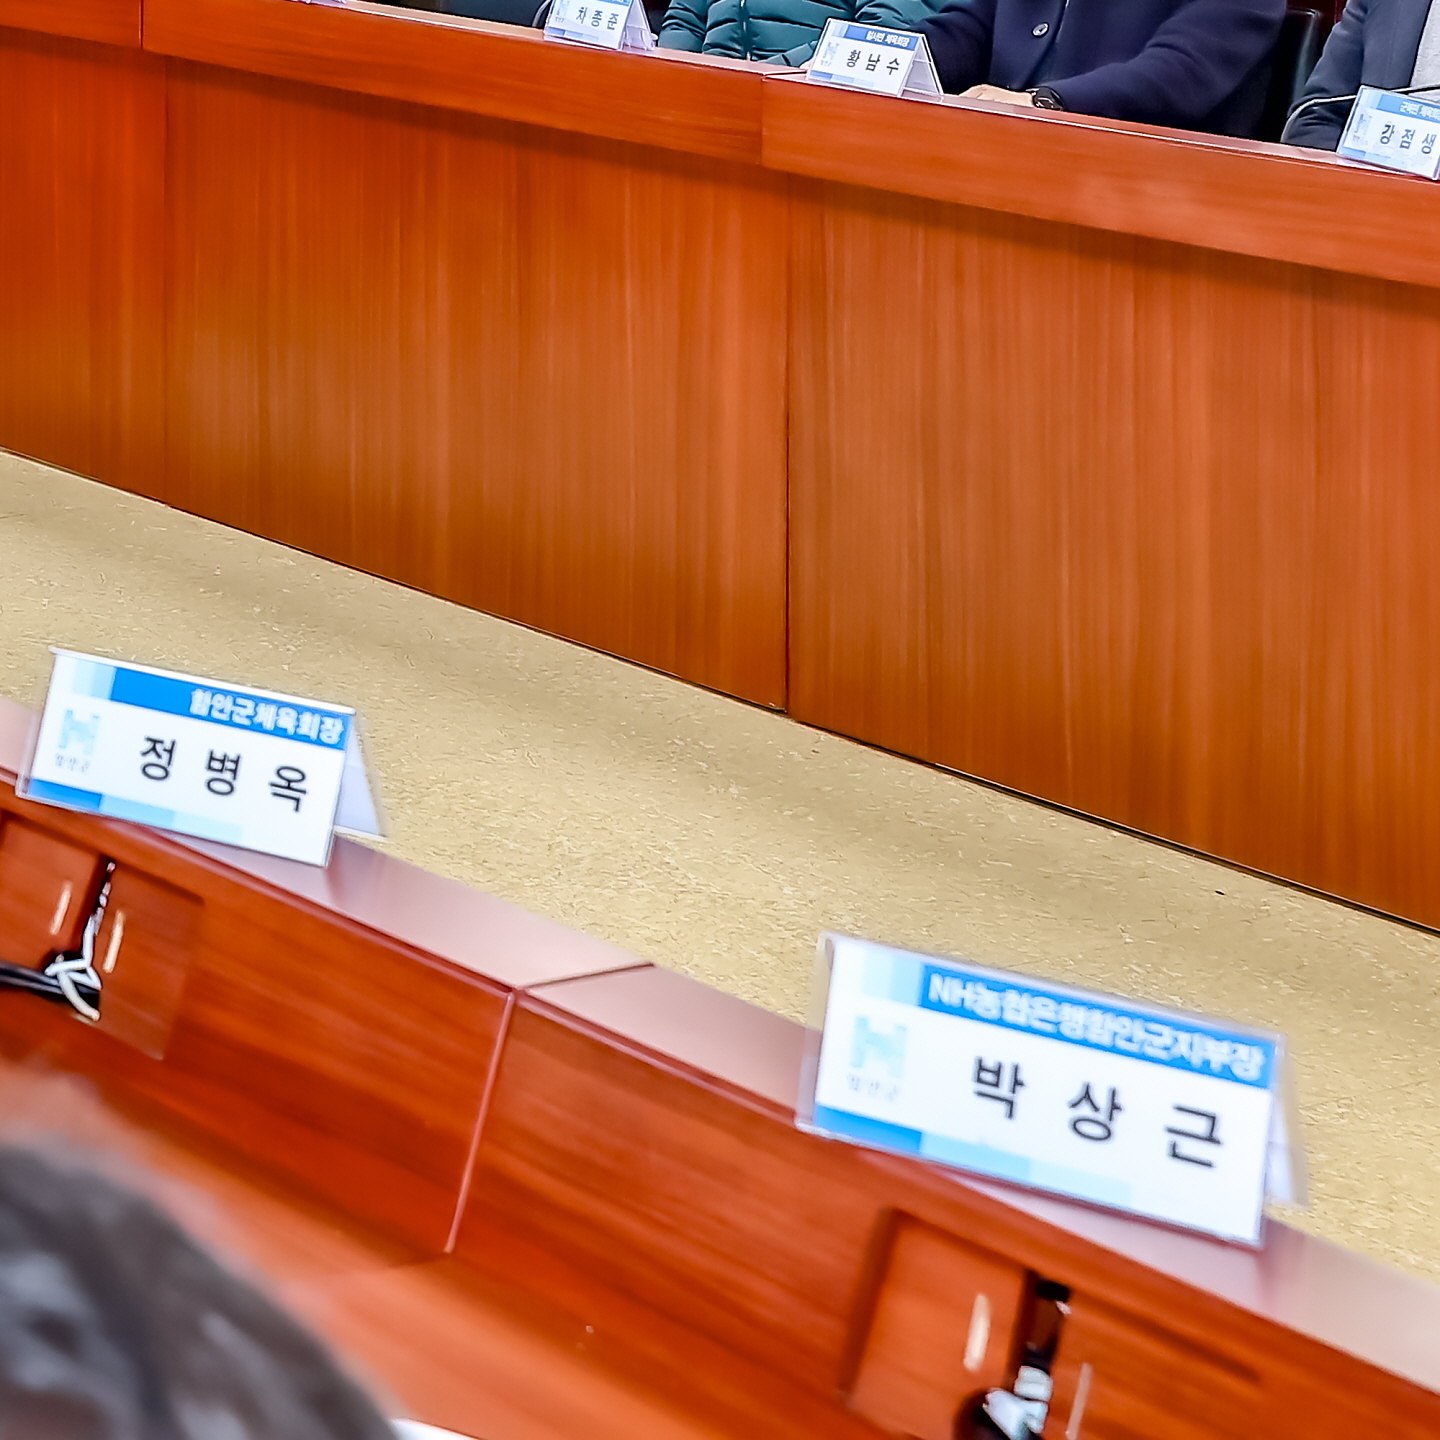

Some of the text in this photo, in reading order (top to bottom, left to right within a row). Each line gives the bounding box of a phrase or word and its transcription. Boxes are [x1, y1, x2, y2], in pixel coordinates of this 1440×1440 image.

[189, 688, 345, 746] 함안군체육회장
[140, 735, 308, 813] 정병옥
[972, 1055, 1223, 1169] 박상근
